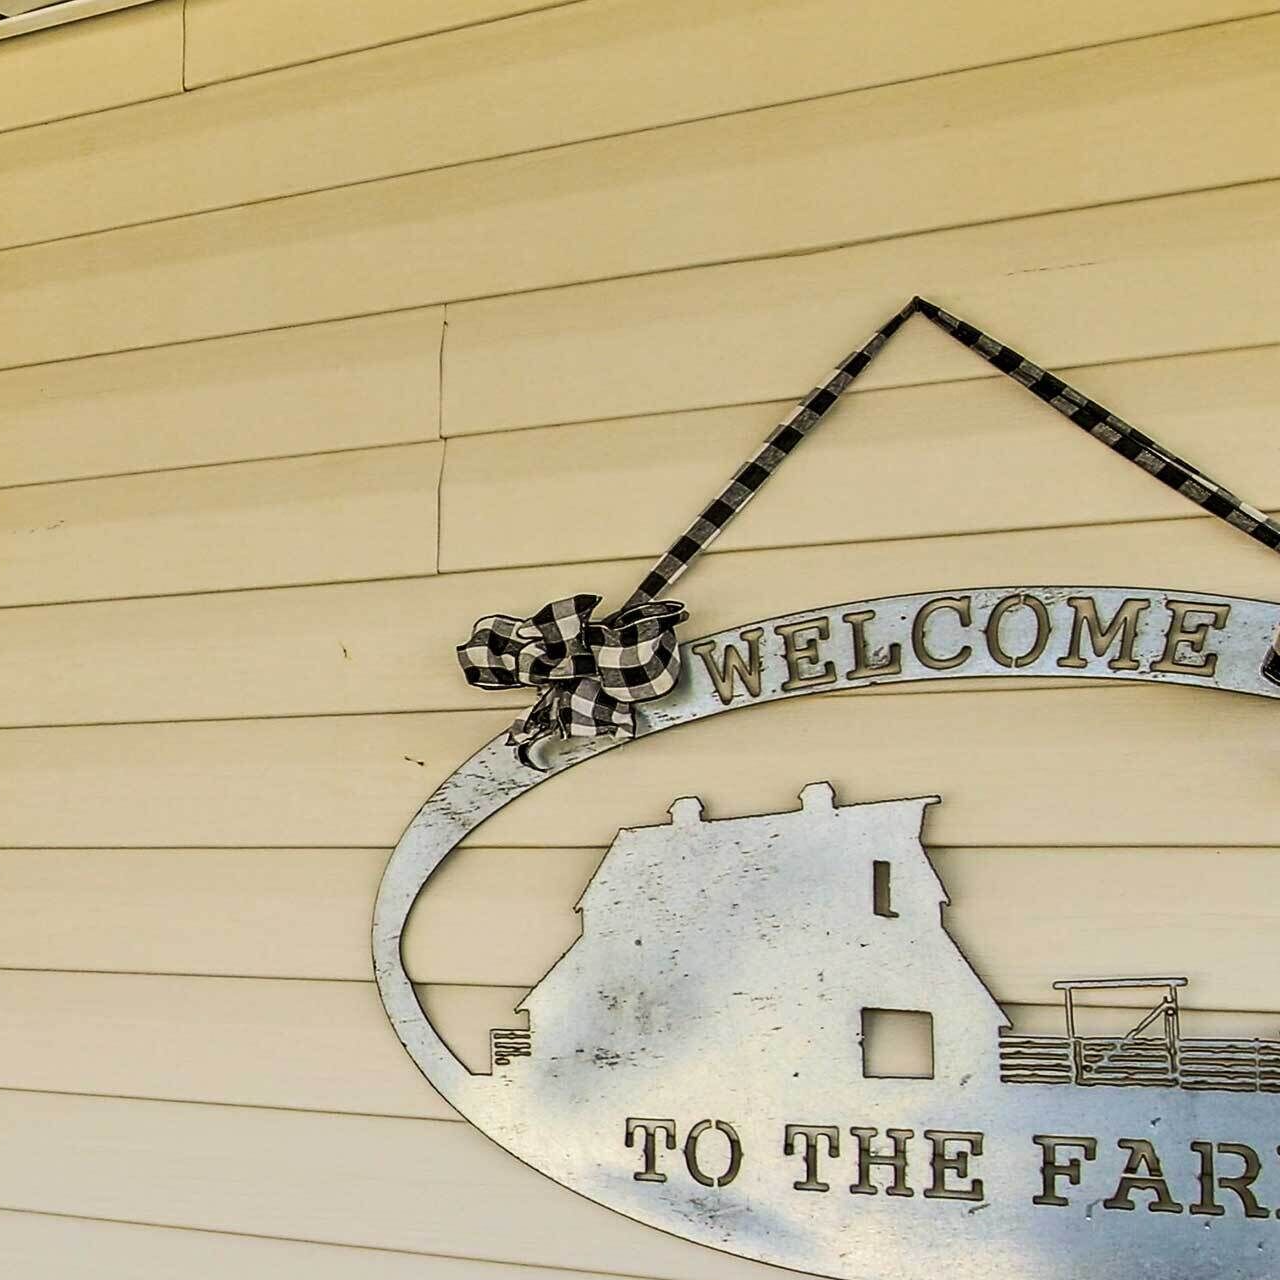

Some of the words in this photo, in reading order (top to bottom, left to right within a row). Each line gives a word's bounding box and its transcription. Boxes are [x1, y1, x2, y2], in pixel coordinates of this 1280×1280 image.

[692, 595, 1231, 706] WELCOME
[625, 1117, 743, 1188] TO
[784, 1124, 984, 1201] THE
[1032, 1134, 1280, 1219] FAR
